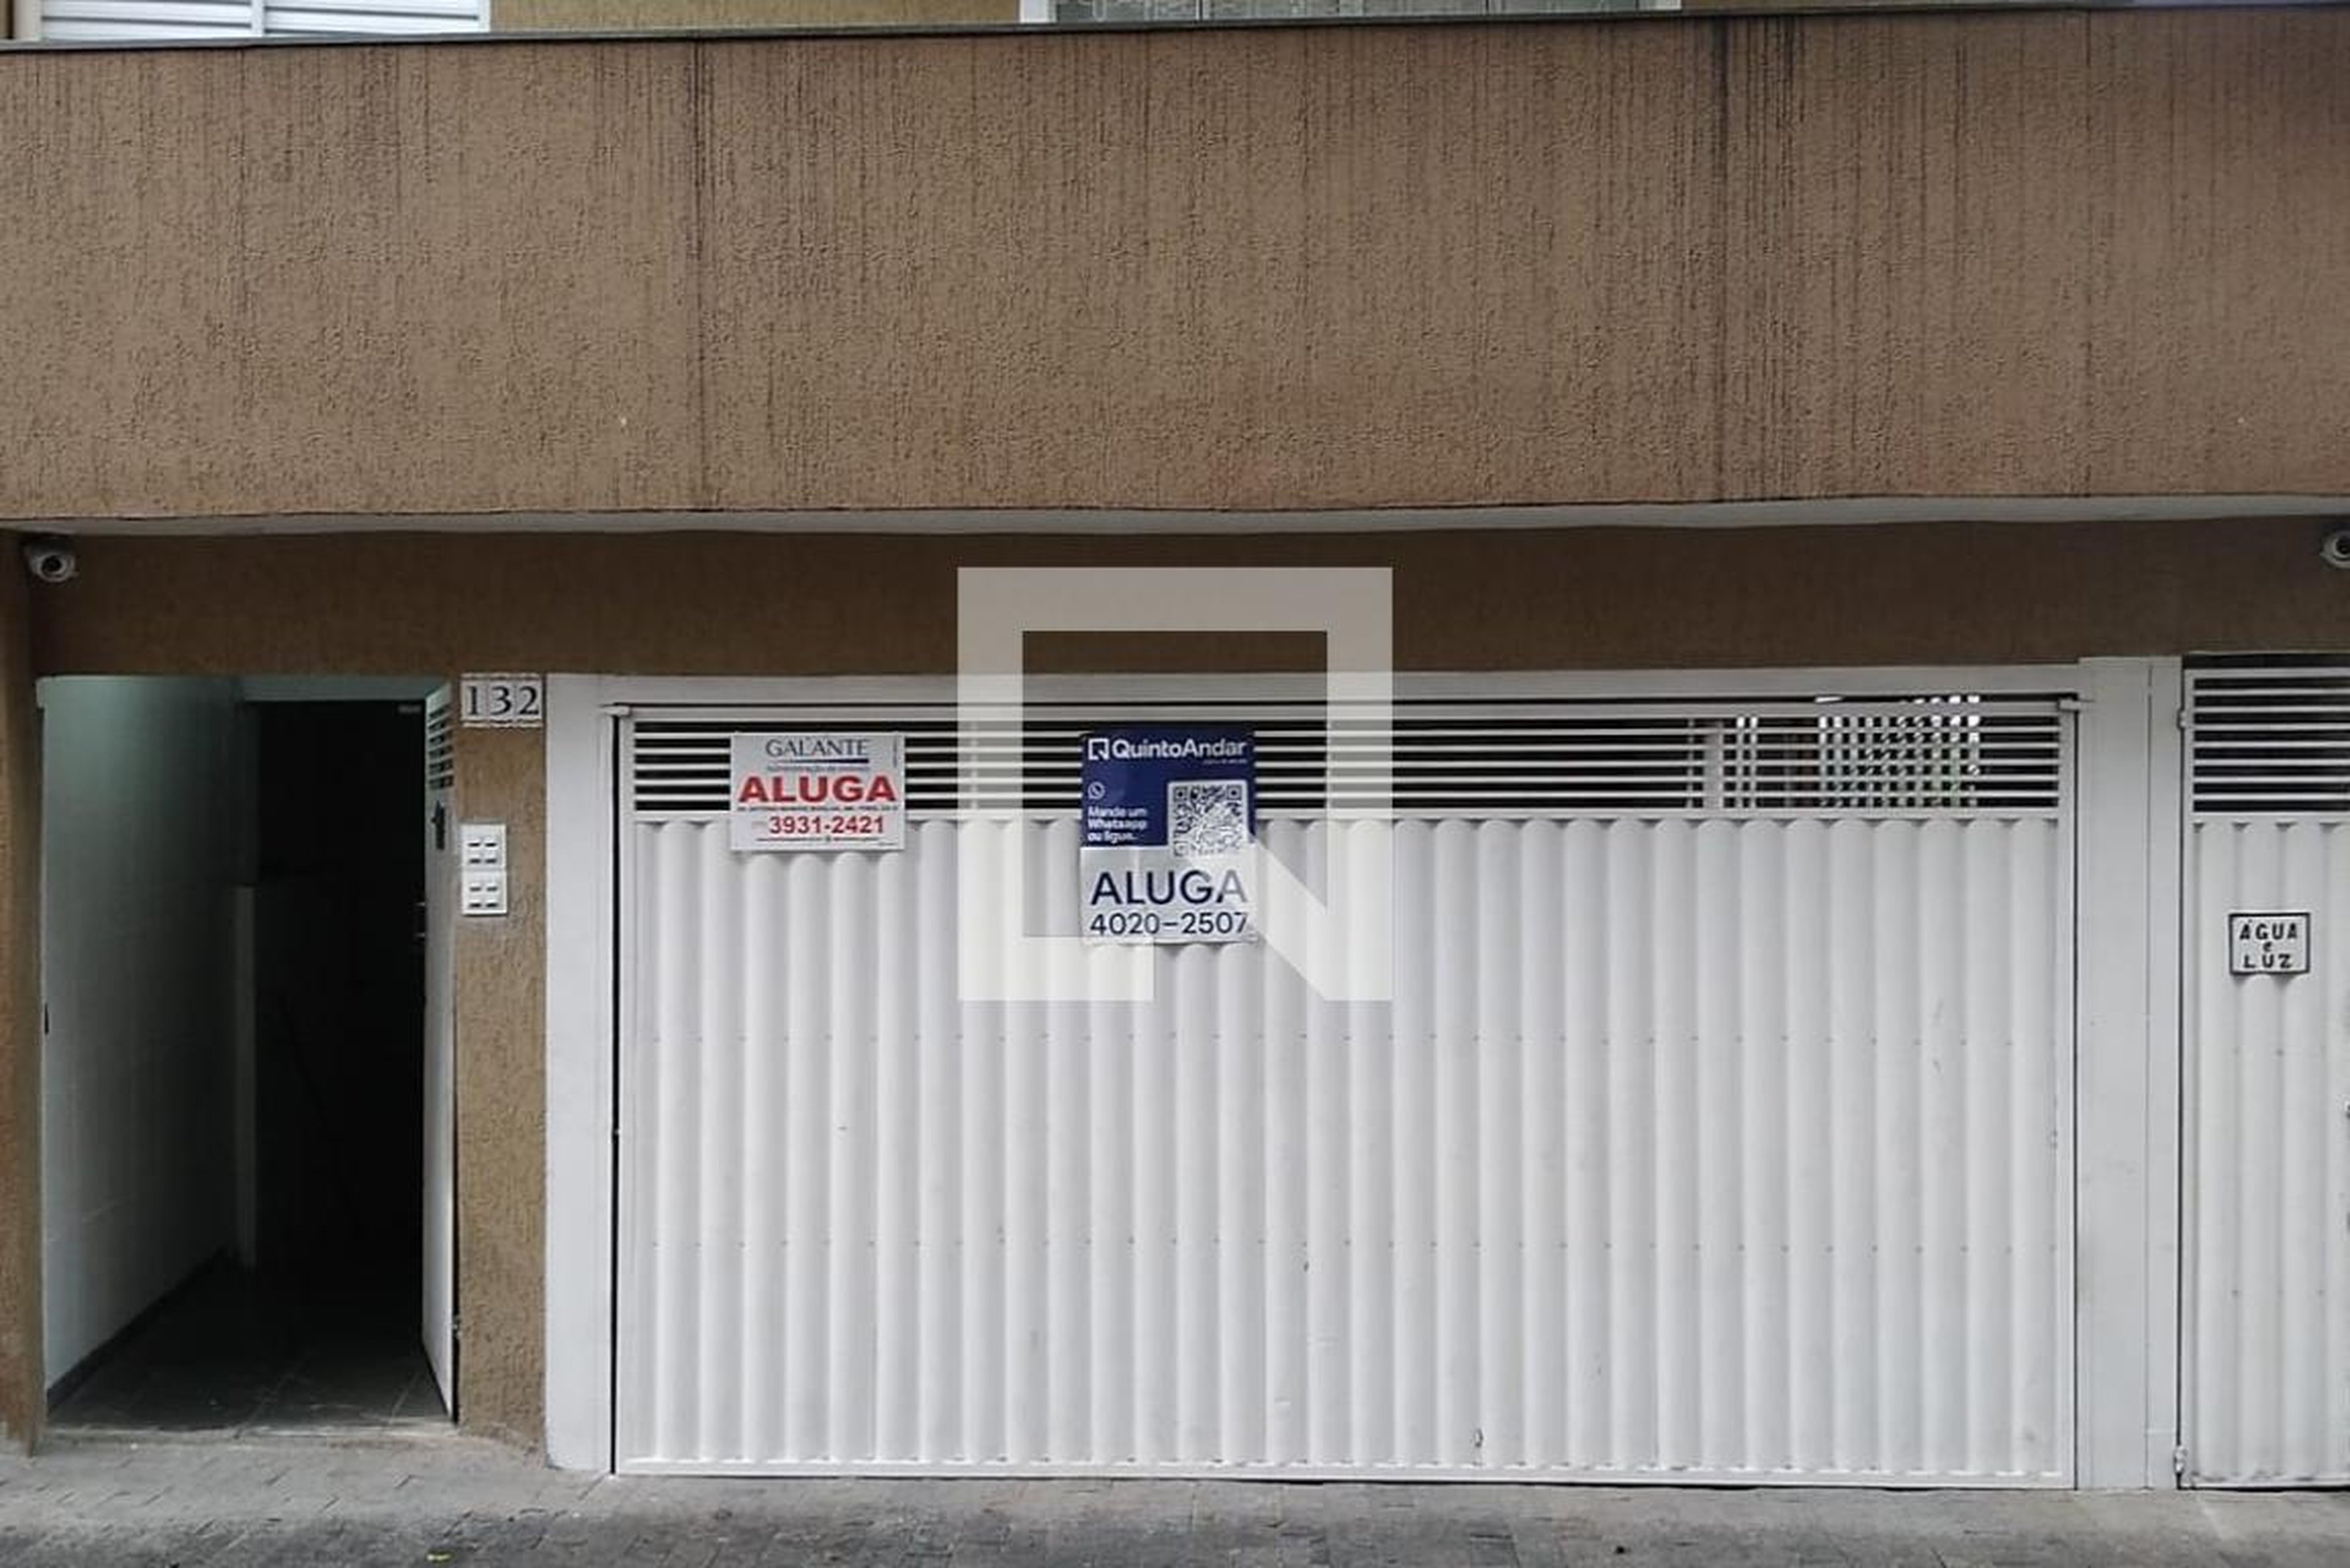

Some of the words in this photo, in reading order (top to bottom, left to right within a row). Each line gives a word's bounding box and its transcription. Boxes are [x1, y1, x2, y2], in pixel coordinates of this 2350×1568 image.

[467, 685, 540, 716] 132
[766, 738, 871, 757] GALANTE
[1112, 738, 1247, 759] QuintoAndar
[738, 775, 897, 803] ALUGA
[769, 815, 884, 834] 3931-2421
[1090, 868, 1248, 905] ALUGA
[1089, 912, 1248, 936] 4020-2507
[2242, 953, 2292, 968] LUZ
